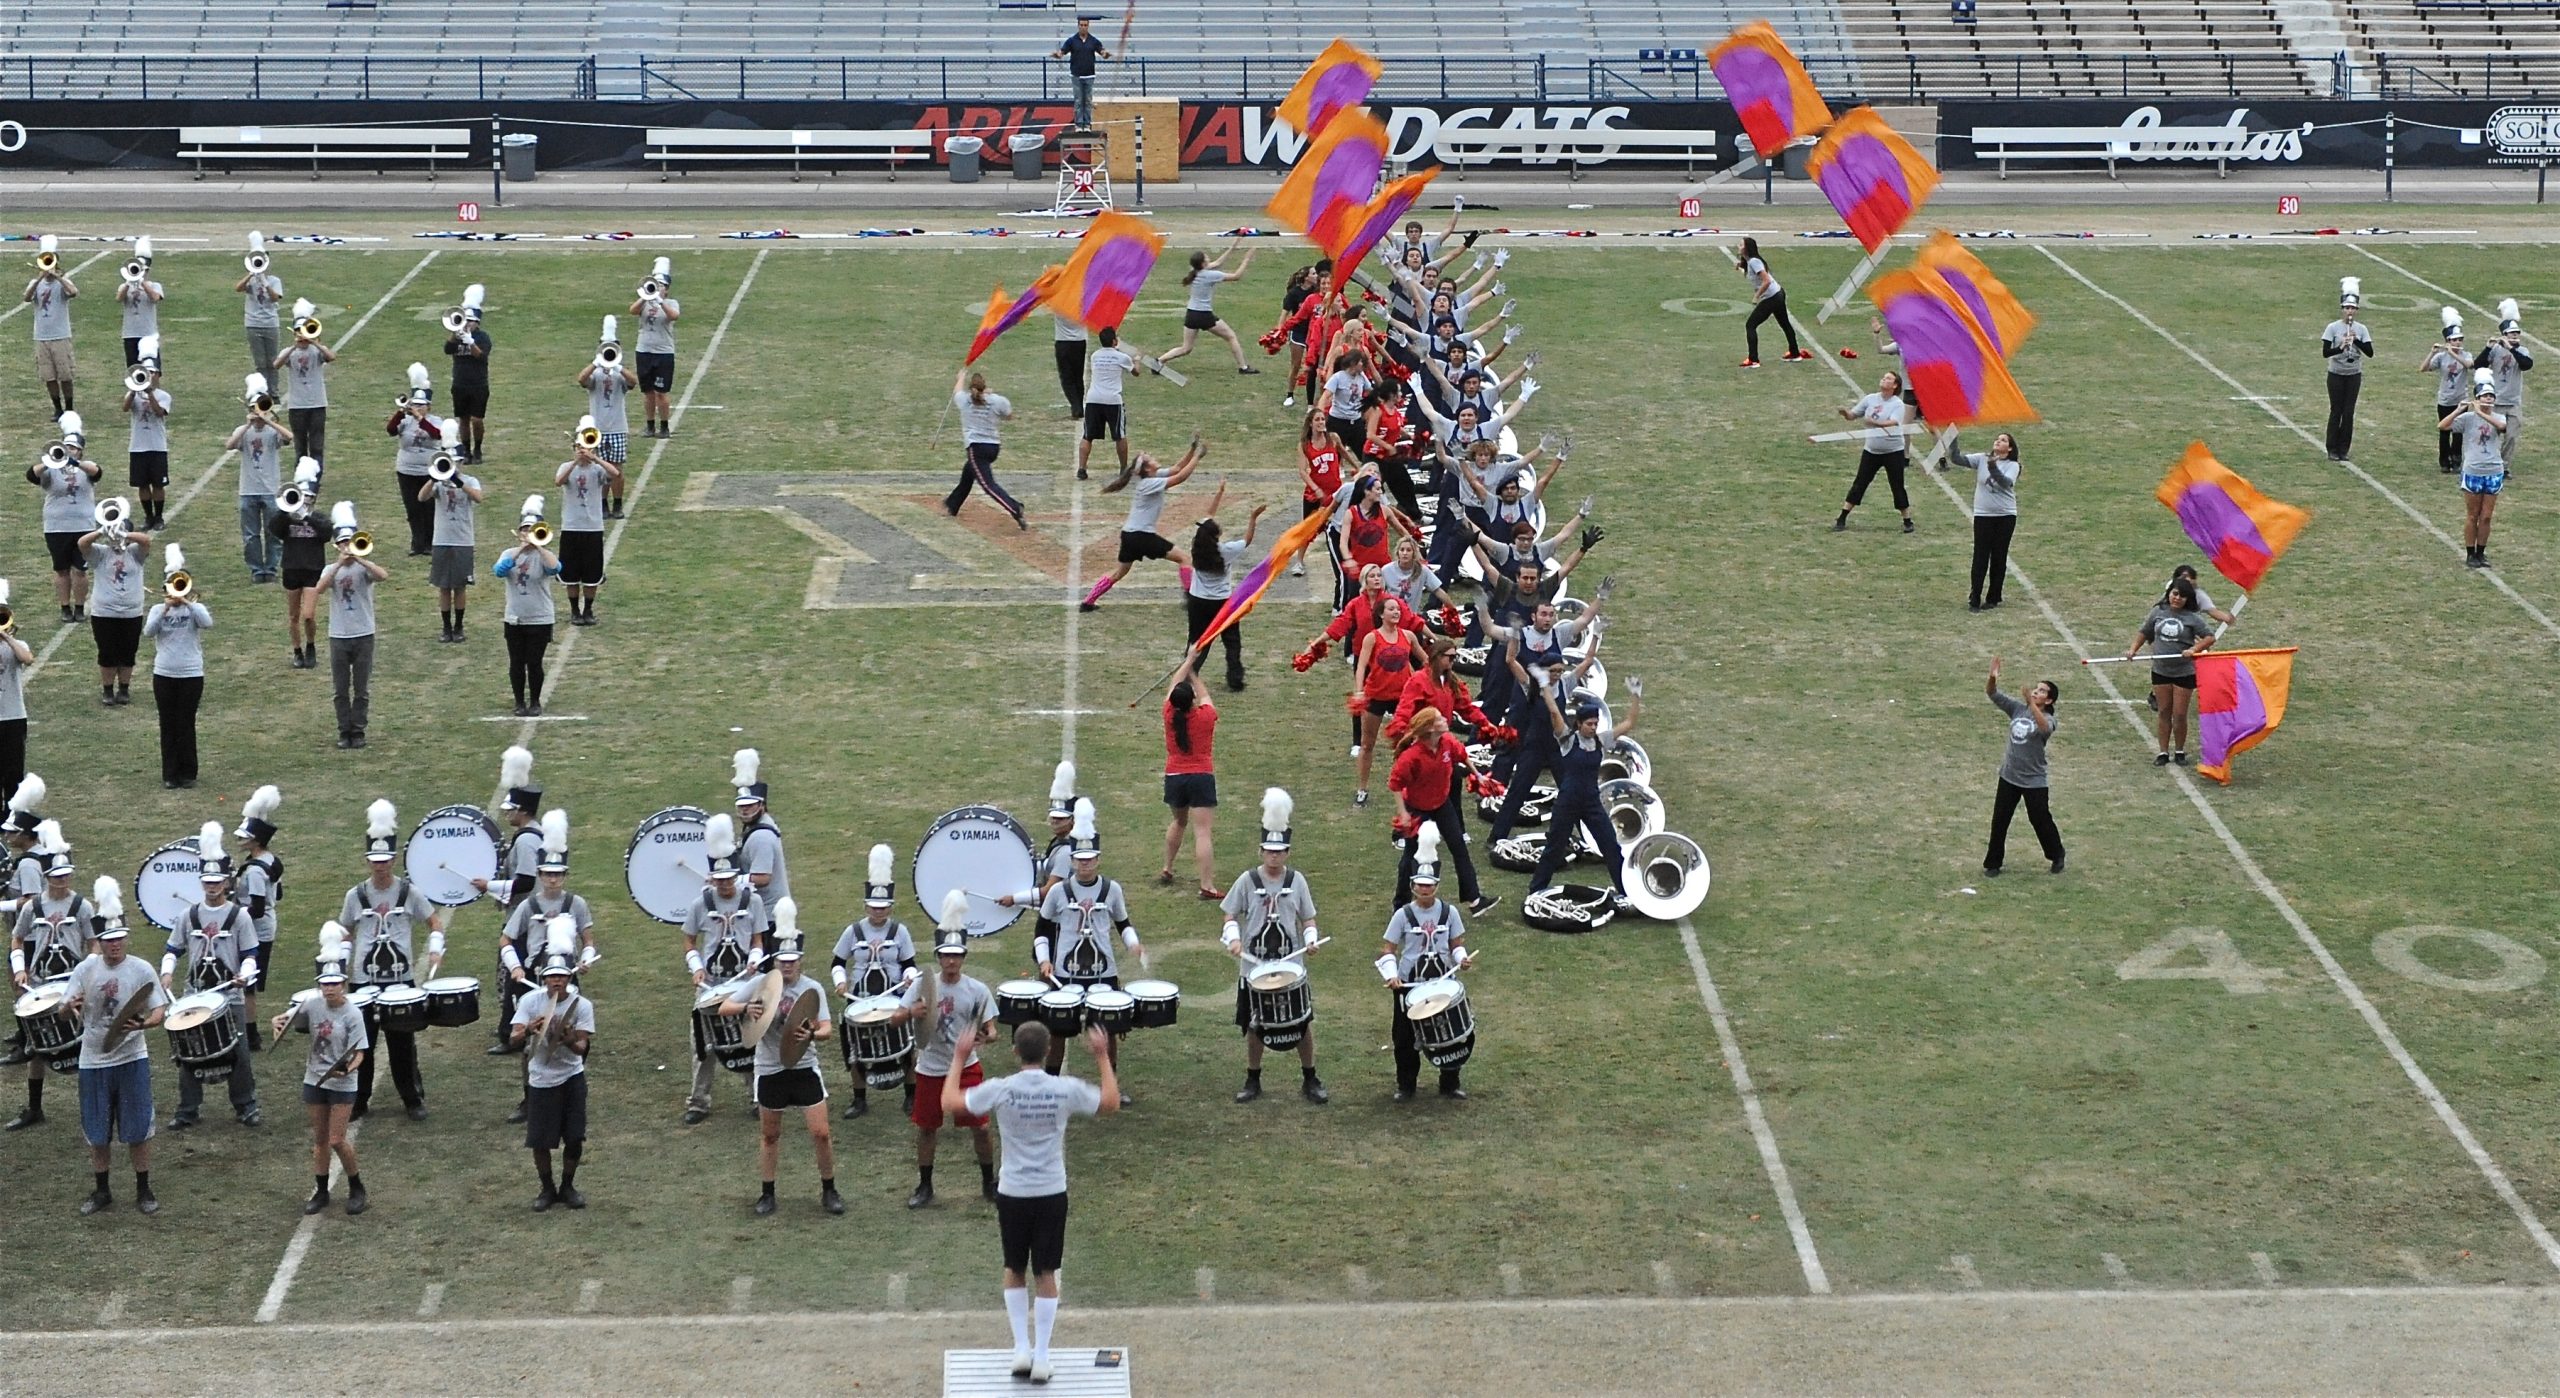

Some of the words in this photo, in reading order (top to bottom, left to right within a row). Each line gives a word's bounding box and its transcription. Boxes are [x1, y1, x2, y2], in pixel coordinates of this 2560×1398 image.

[894, 106, 1242, 165] ARIZA
[1243, 104, 1630, 165] WDCATS
[1074, 170, 1093, 186] 50
[459, 203, 478, 221] 40
[1683, 200, 1700, 217] 40
[2281, 197, 2299, 214] 30
[435, 826, 476, 839] YAMAHA
[666, 831, 706, 843] YAMAHA
[962, 830, 1001, 840] YAMAHA
[165, 862, 201, 873] YAMAH
[1272, 1032, 1302, 1045] YAMAHA
[1441, 1046, 1470, 1064] YAMAHA
[876, 1069, 905, 1083] YAMAHA
